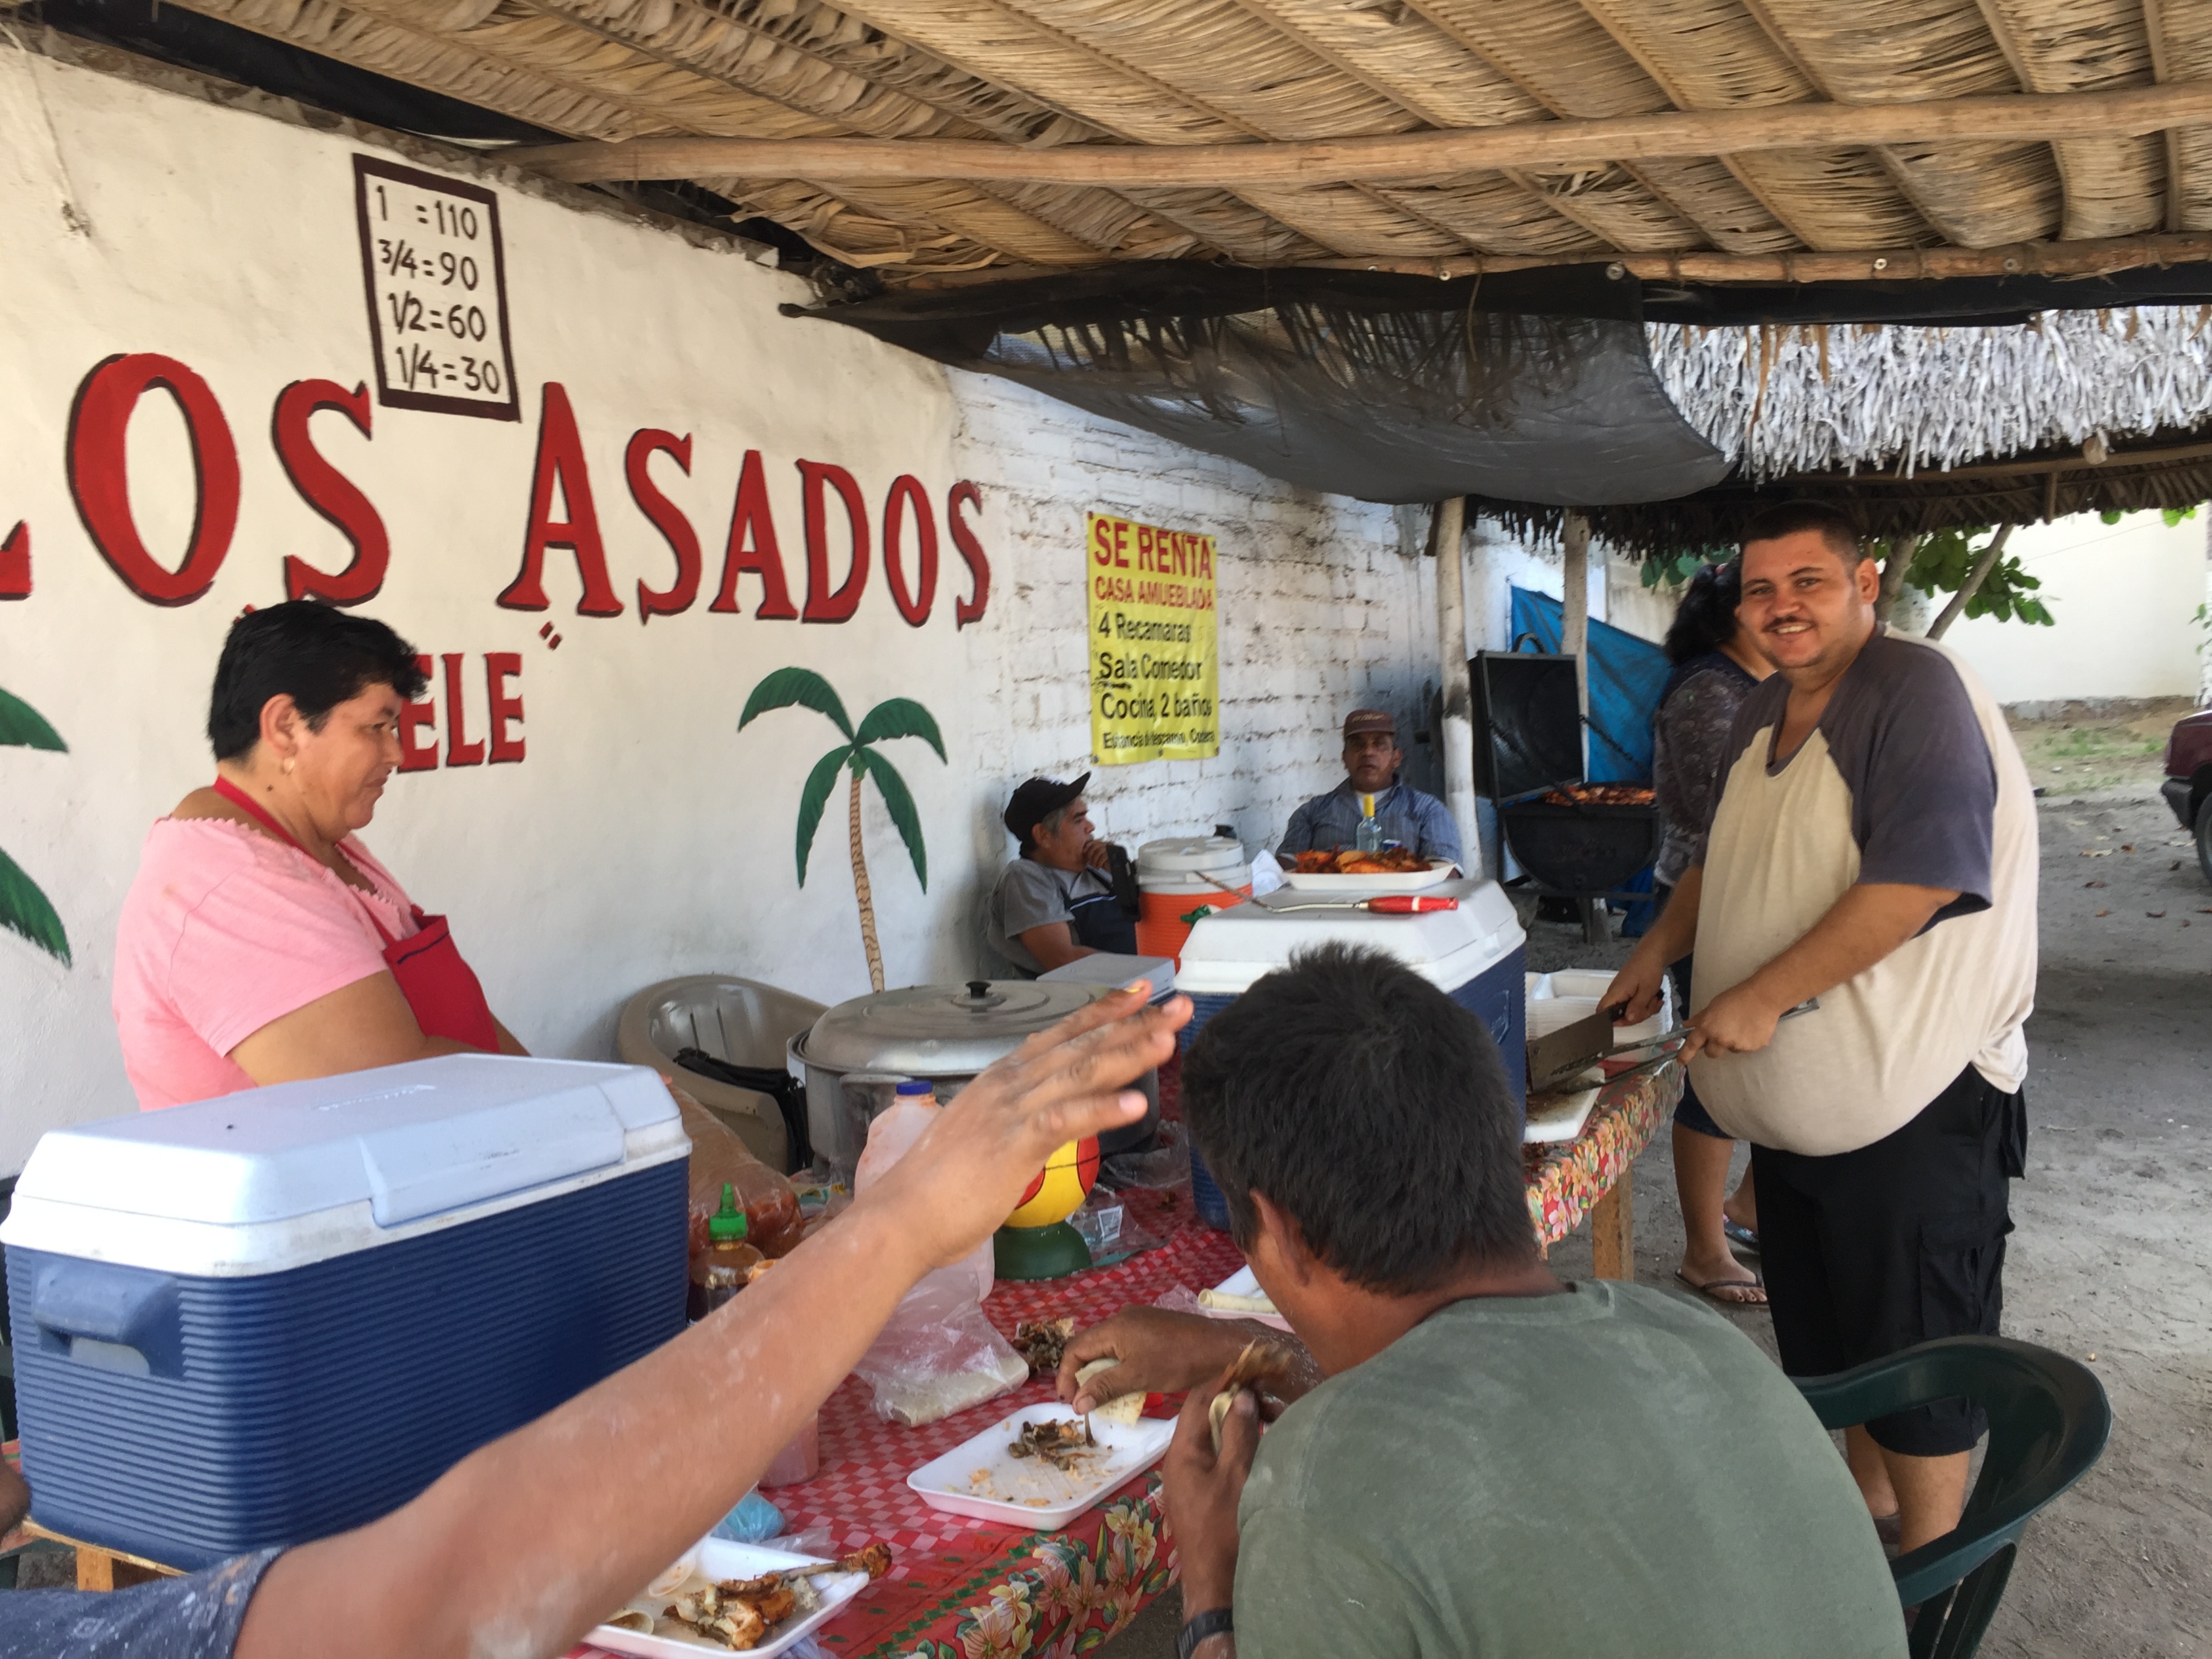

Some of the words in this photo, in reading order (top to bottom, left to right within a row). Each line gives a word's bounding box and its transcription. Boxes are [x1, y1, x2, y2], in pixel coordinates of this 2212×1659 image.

[377, 185, 388, 221] 1
[377, 239, 479, 291] 3/4=90
[388, 290, 487, 342] 1/2=60
[396, 342, 500, 394] 1/4=30
[496, 381, 991, 632] ASADOS
[1094, 518, 1129, 569] SE
[1137, 527, 1212, 580] RENTA
[1094, 575, 1134, 604] CASA
[1137, 581, 1214, 611] AMUEBLADA
[1098, 612, 1111, 638] 4
[1115, 613, 1191, 644] Recamaras
[1099, 651, 1138, 680] Sala
[1141, 653, 1203, 681] Comedor
[1160, 692, 1170, 719] 2
[1173, 692, 1212, 720] baños
